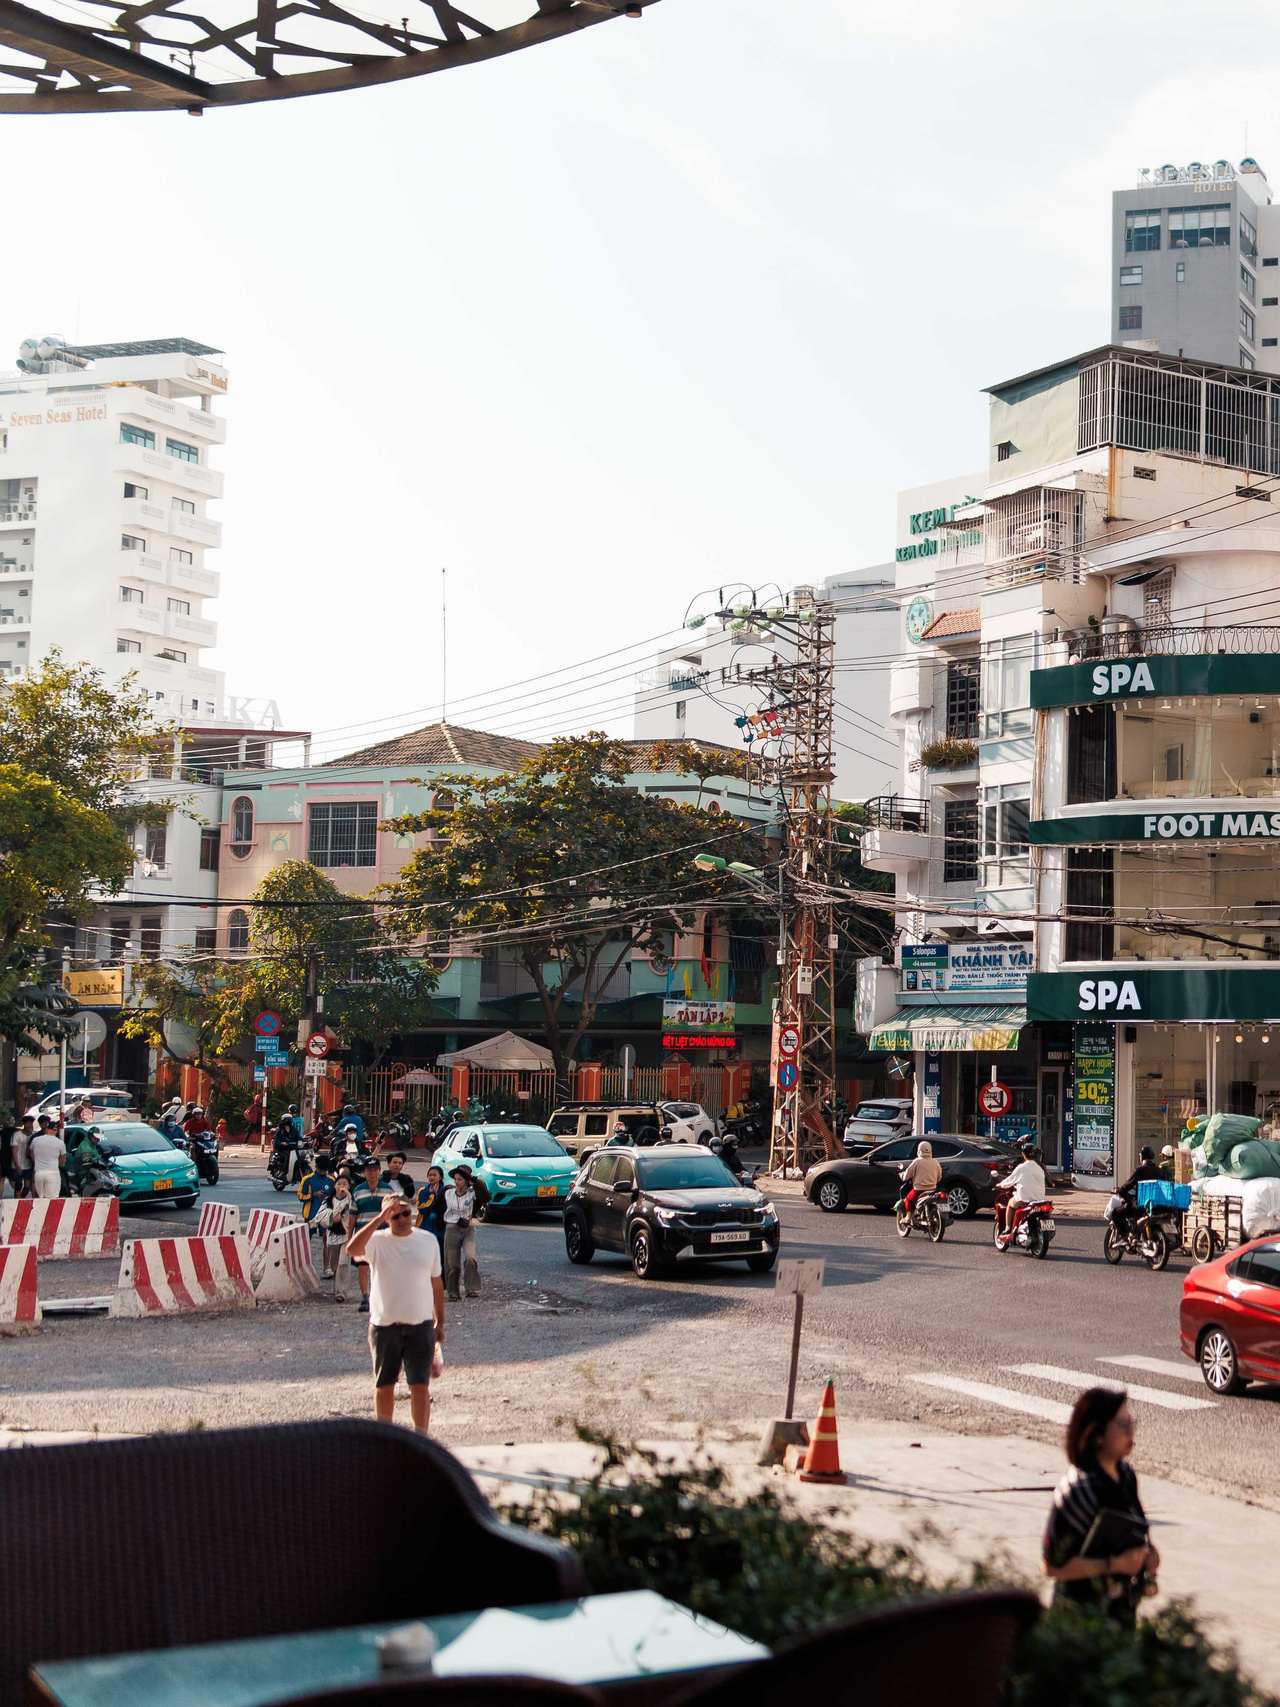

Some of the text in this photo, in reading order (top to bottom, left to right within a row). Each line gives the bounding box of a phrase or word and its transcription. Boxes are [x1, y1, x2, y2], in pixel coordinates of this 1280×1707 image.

[1153, 162, 1235, 185] SEAESTA
[1194, 182, 1233, 193] HOTEL
[10, 404, 108, 427] Seven Seas Hotel
[909, 507, 946, 535] KEM
[895, 544, 916, 562] KEM
[1092, 662, 1155, 695] SPA
[1144, 815, 1214, 838] FOOT
[913, 947, 937, 957] Salonpas
[951, 952, 1003, 968] KHÁNH
[1078, 980, 1142, 1011] SPA
[677, 1007, 725, 1025] TÂN LẬP 2
[877, 1035, 910, 1048] Eugica
[1078, 1059, 1112, 1067] HAPPY HOUR
[1094, 1096, 1110, 1105] OFF
